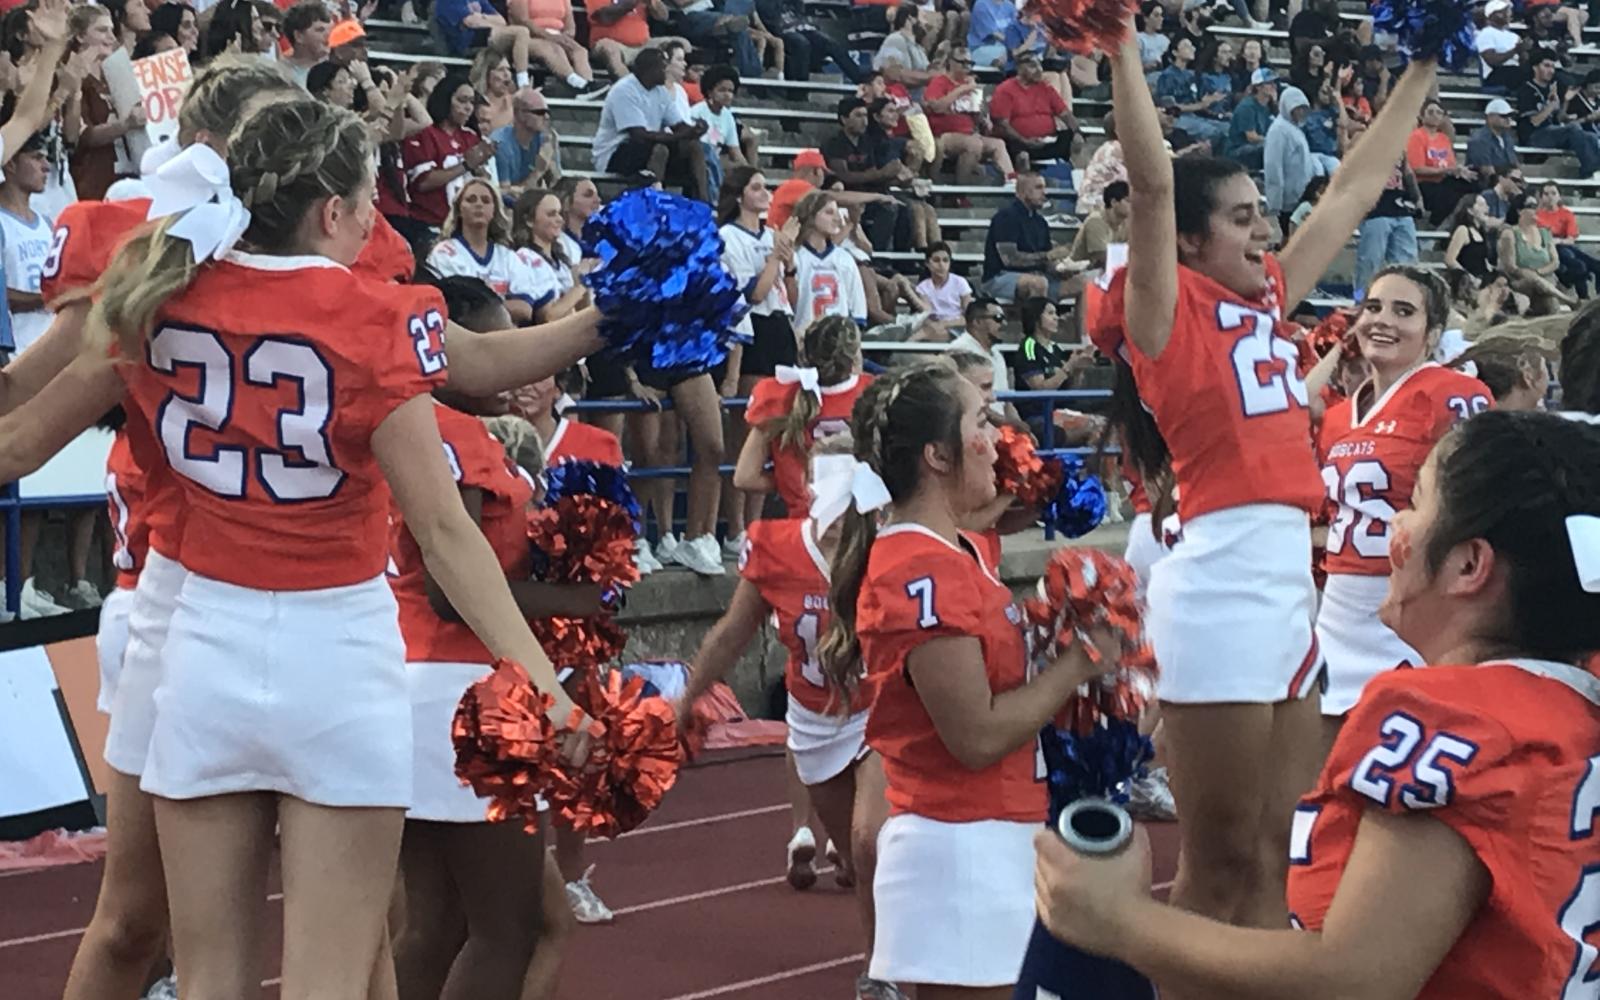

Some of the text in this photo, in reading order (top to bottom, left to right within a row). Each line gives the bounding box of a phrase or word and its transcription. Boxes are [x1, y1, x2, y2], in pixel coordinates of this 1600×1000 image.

[132, 50, 187, 89] ENSE
[143, 87, 181, 123] OP
[811, 271, 839, 319] 2
[407, 308, 448, 377] 23
[146, 319, 348, 504] 23
[905, 575, 940, 630] 7
[1350, 710, 1480, 810] 25
